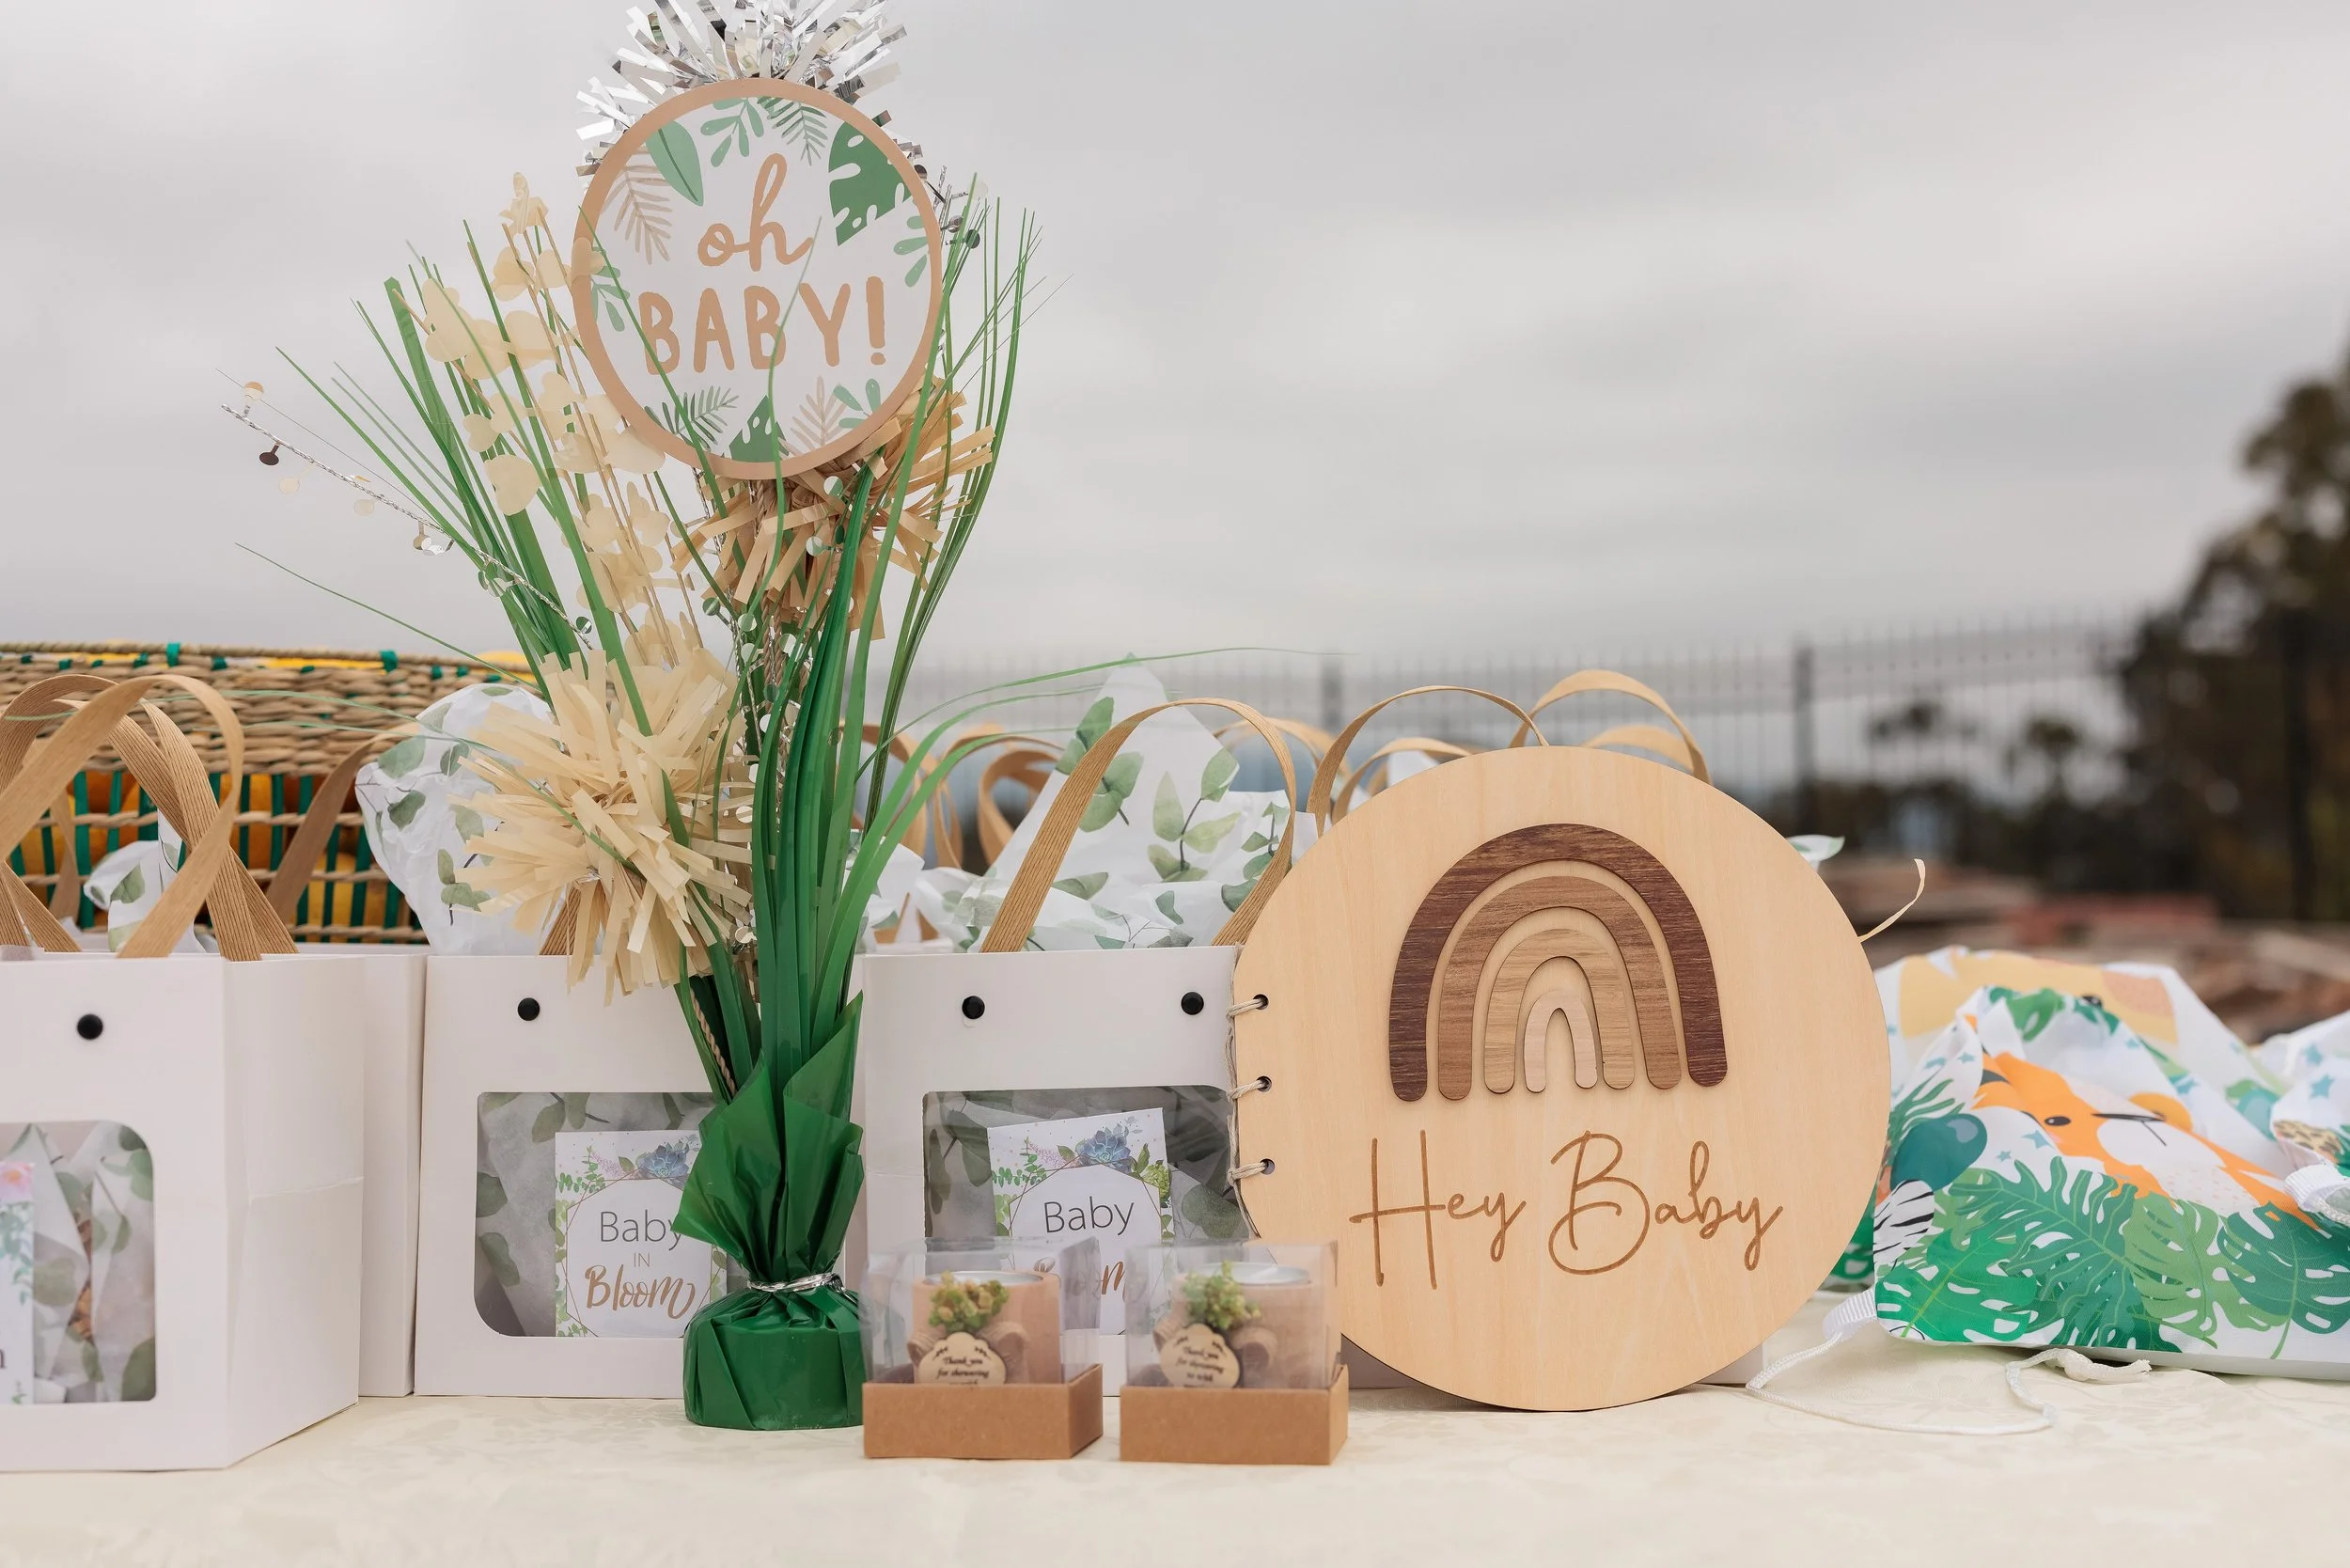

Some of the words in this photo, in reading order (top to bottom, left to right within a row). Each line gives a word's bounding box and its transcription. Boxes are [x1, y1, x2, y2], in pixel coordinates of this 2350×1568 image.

[697, 151, 814, 273] oh
[637, 274, 886, 376] BABY!
[1043, 1196, 1135, 1236] Baby
[1348, 1128, 1528, 1291] Hey
[1547, 1129, 1784, 1277] Baby
[633, 1252, 651, 1268] IN
[584, 1263, 697, 1320] Bloom
[935, 1367, 949, 1380] for
[942, 1356, 966, 1365] Thank
